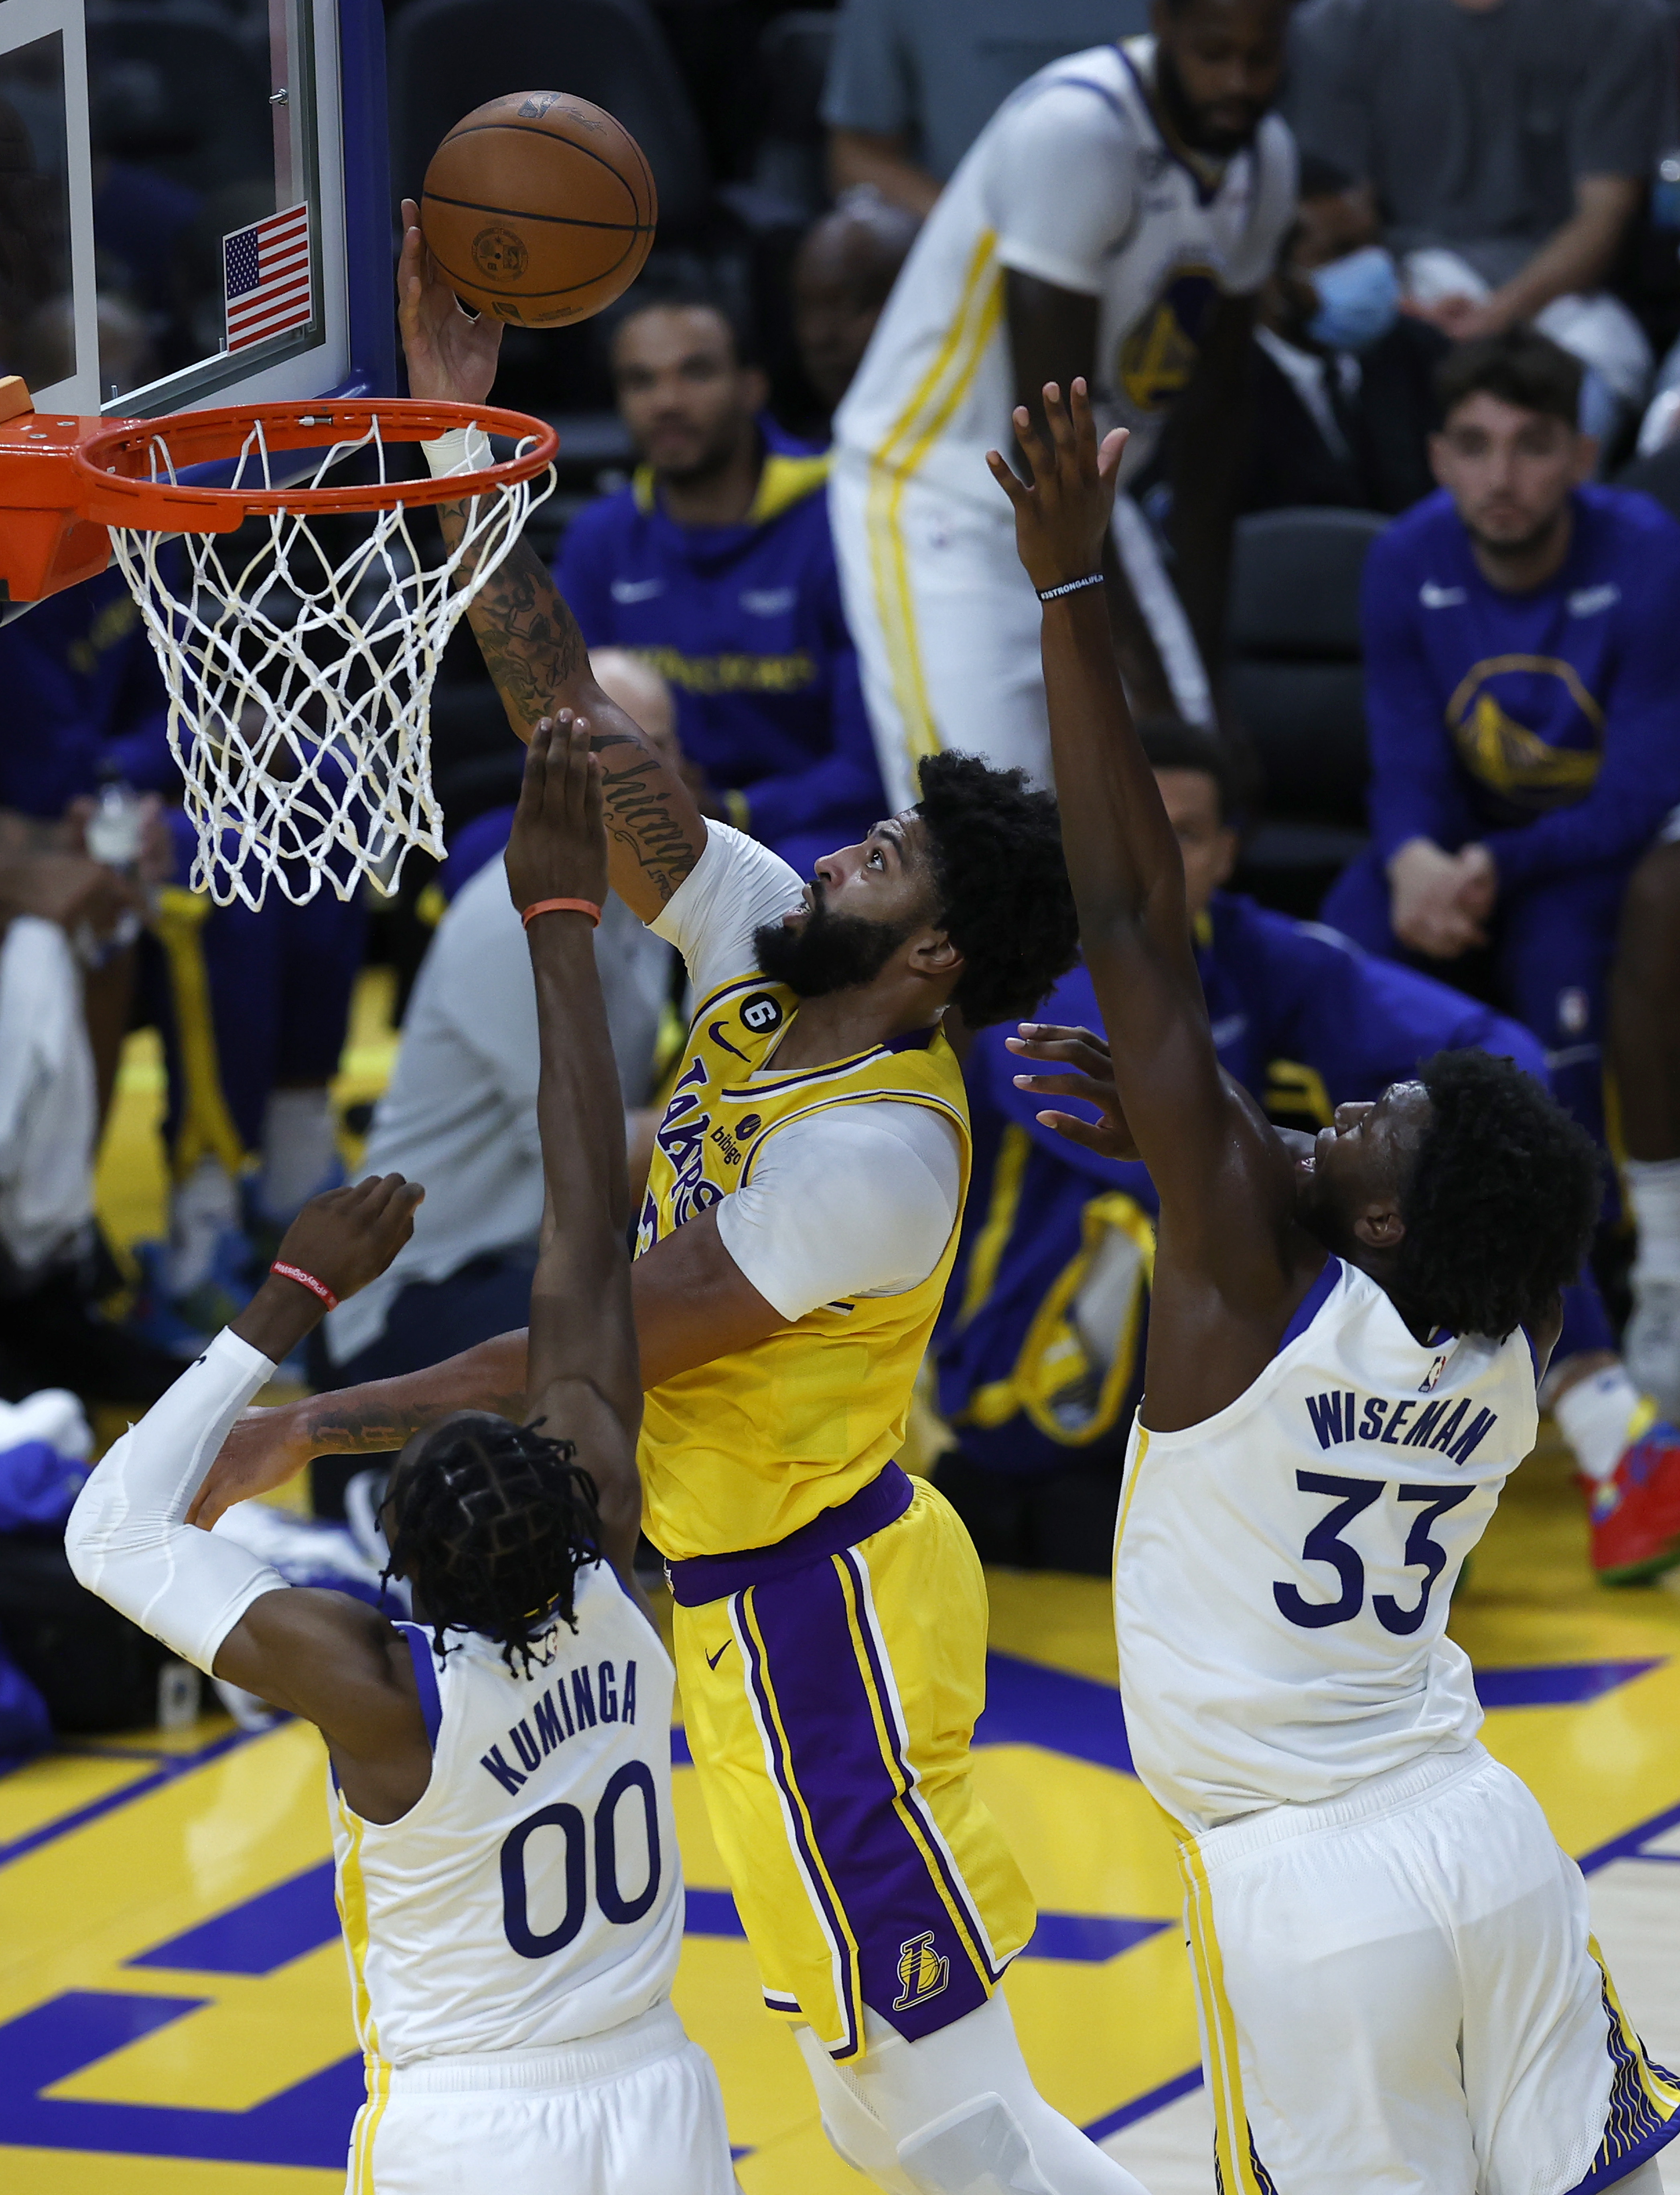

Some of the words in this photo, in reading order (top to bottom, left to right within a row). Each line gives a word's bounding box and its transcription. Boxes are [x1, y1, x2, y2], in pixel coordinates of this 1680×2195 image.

[745, 1000, 777, 1027] 6
[710, 1126, 741, 1165] bibigo
[1305, 1390, 1497, 1466] WISEMAN
[1273, 1469, 1477, 1635] 33
[479, 1660, 637, 1796] KUMINGA
[501, 1760, 661, 1959] 00
